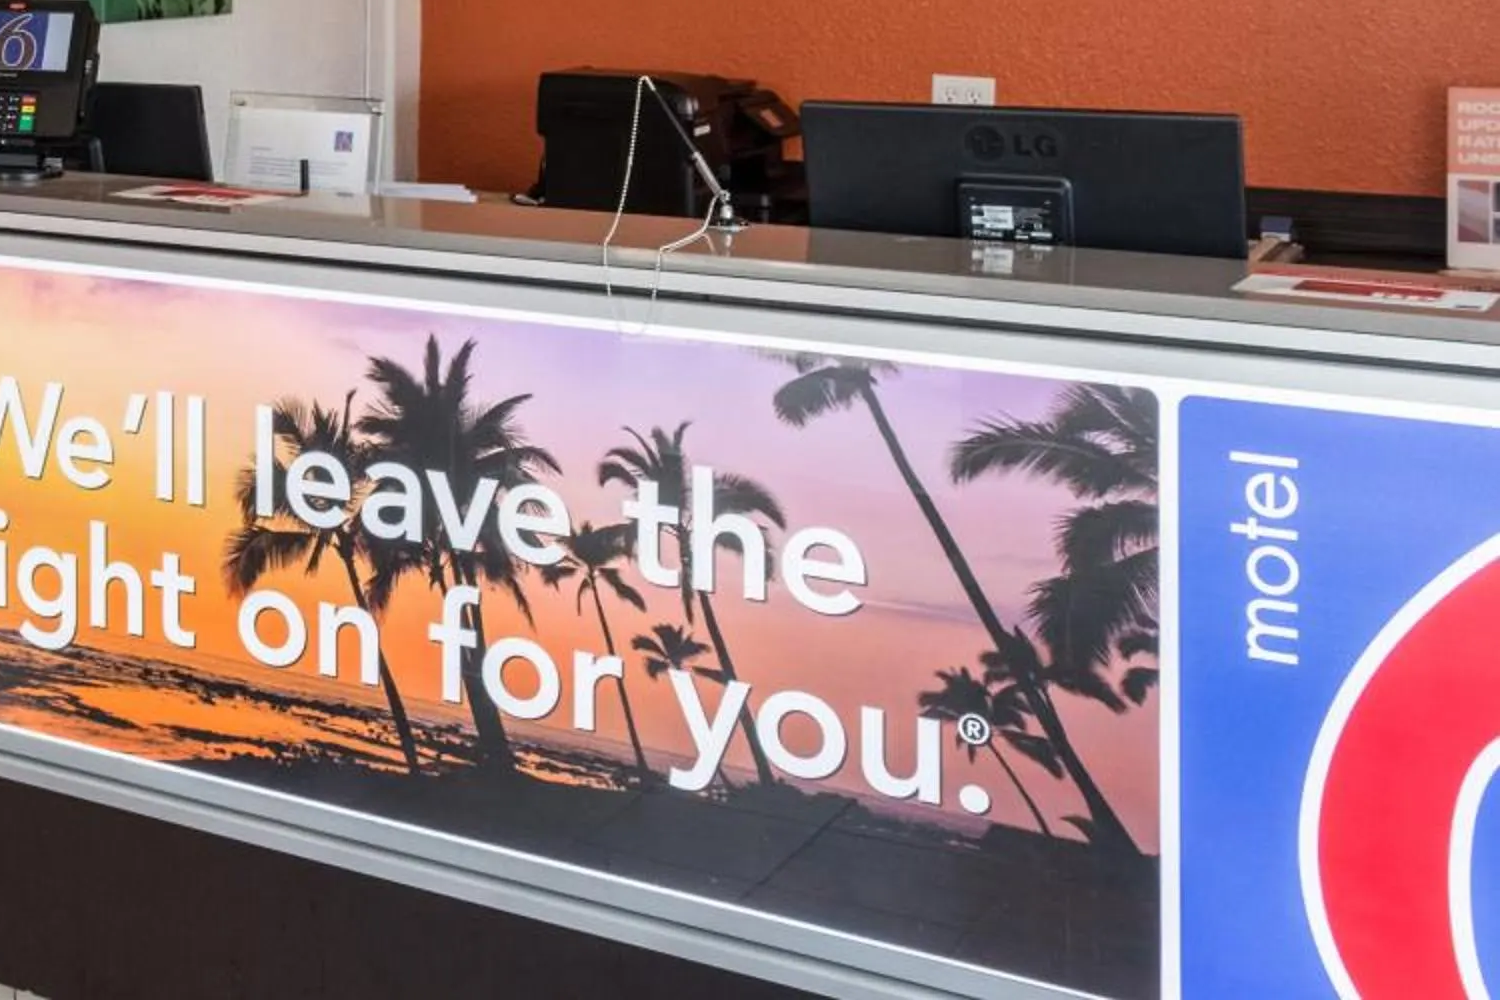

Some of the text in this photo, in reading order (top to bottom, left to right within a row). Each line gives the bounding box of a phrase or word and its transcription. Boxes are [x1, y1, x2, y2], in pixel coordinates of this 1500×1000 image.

[1013, 134, 1058, 158] LG
[255, 404, 572, 566] leave
[621, 465, 868, 616] the
[1229, 450, 1299, 665] motel
[237, 588, 382, 687] on
[428, 582, 625, 733] for
